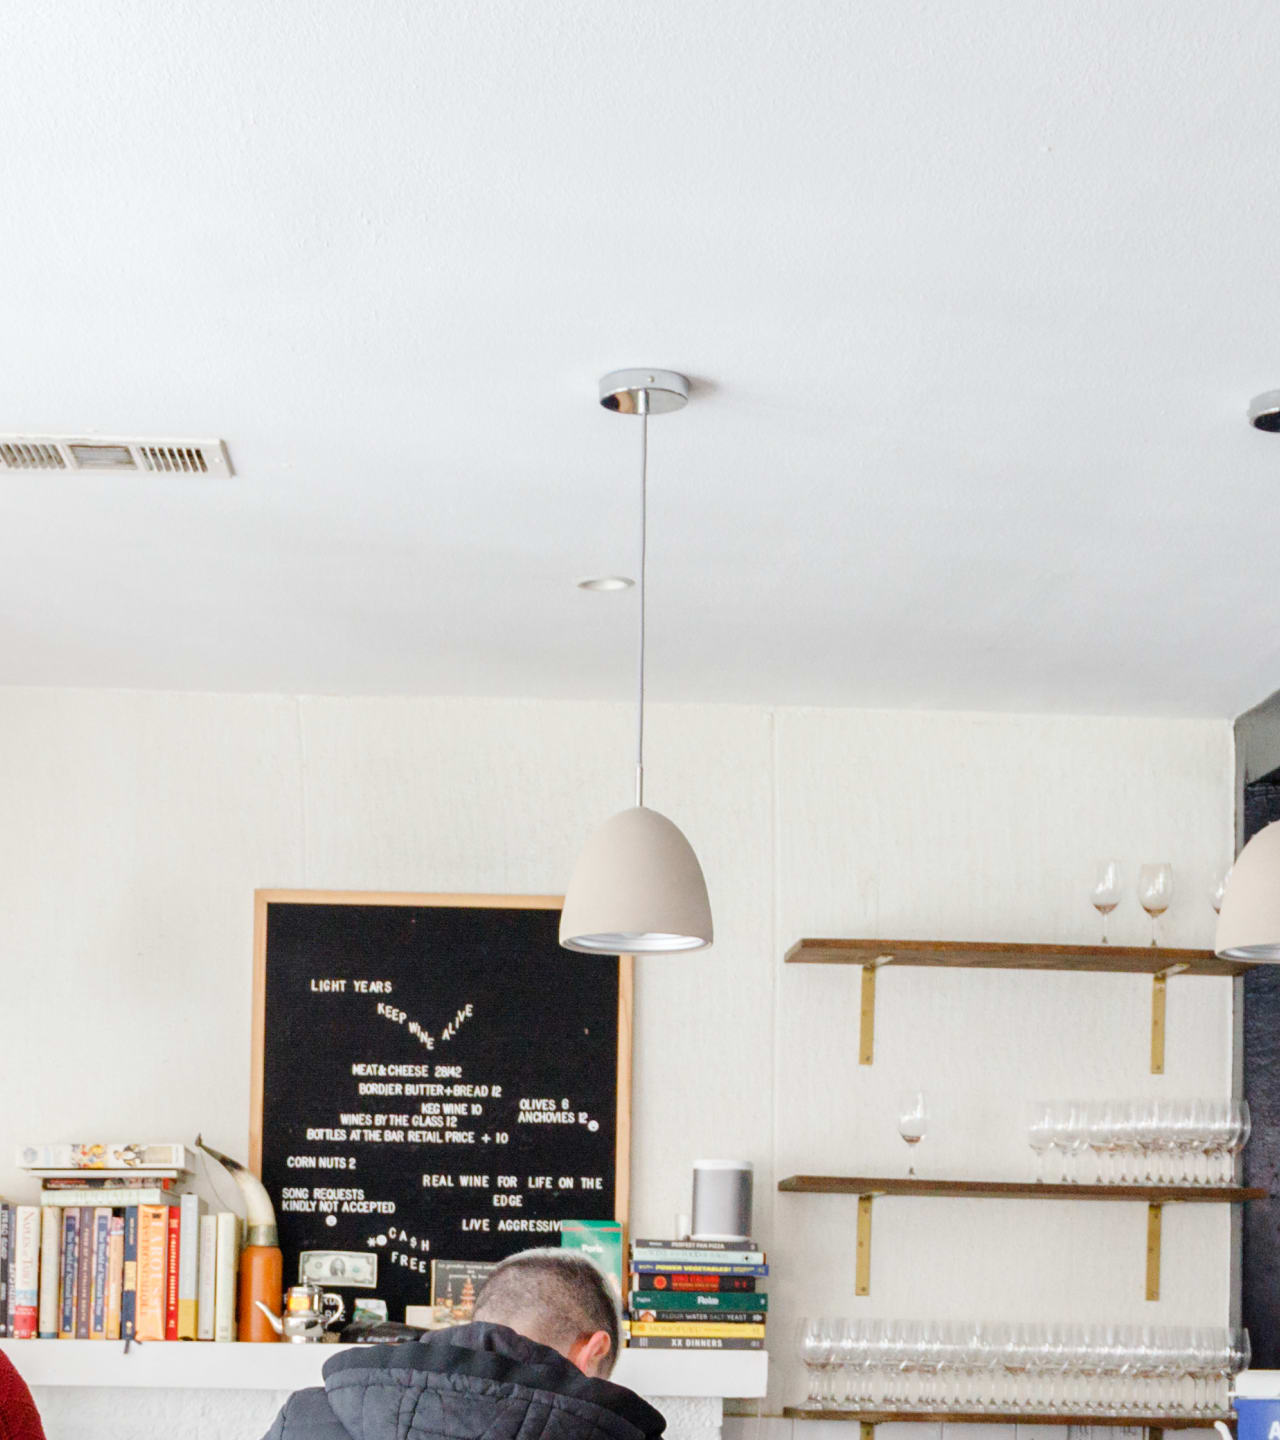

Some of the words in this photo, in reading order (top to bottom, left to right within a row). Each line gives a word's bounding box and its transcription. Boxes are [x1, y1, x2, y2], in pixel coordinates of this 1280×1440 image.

[311, 979, 346, 992] LIGHT
[353, 980, 392, 993] YEARS
[377, 1003, 407, 1024] KEEP
[408, 1022, 434, 1050] WINE
[442, 1004, 473, 1040] ALIVE
[359, 1083, 402, 1096] BORDIER
[492, 1086, 502, 1098] 12
[421, 1103, 440, 1115] KEG
[442, 1104, 468, 1116] WINE
[471, 1104, 482, 1116] 10
[519, 1099, 556, 1111] OLIVES
[340, 1114, 372, 1126] WINES
[374, 1114, 388, 1126] BY
[390, 1114, 409, 1126] THE
[412, 1114, 444, 1127] GLASS
[446, 1116, 458, 1127] 12
[518, 1112, 575, 1124] ANCHOVIES
[578, 1112, 588, 1124] 12
[307, 1129, 346, 1140] BOTTLES
[350, 1130, 362, 1141] AT
[363, 1130, 382, 1142] THE
[384, 1130, 404, 1142] BAR
[408, 1131, 443, 1143] RETAIL
[445, 1132, 474, 1143] PRICE
[495, 1132, 509, 1144] 10
[287, 1156, 316, 1168] CORN
[318, 1157, 346, 1169] NUTS
[348, 1158, 356, 1169] 2
[423, 1174, 454, 1187] REAL
[460, 1175, 490, 1187] WINE
[497, 1176, 518, 1188] FOR
[528, 1176, 553, 1189] LIFE
[558, 1177, 574, 1189] ON
[580, 1178, 602, 1189] THE
[282, 1188, 309, 1199] SONG
[314, 1188, 364, 1200] REQUESTS
[282, 1200, 316, 1212] KINDLY
[320, 1201, 339, 1213] NOT
[342, 1202, 396, 1213] ACCEPTED
[493, 1195, 523, 1207] EDGE
[462, 1219, 490, 1231] LIVE
[498, 1220, 563, 1232] AGGRESSIV
[391, 1252, 427, 1273] FREE
[686, 1339, 723, 1347] DINNERS
